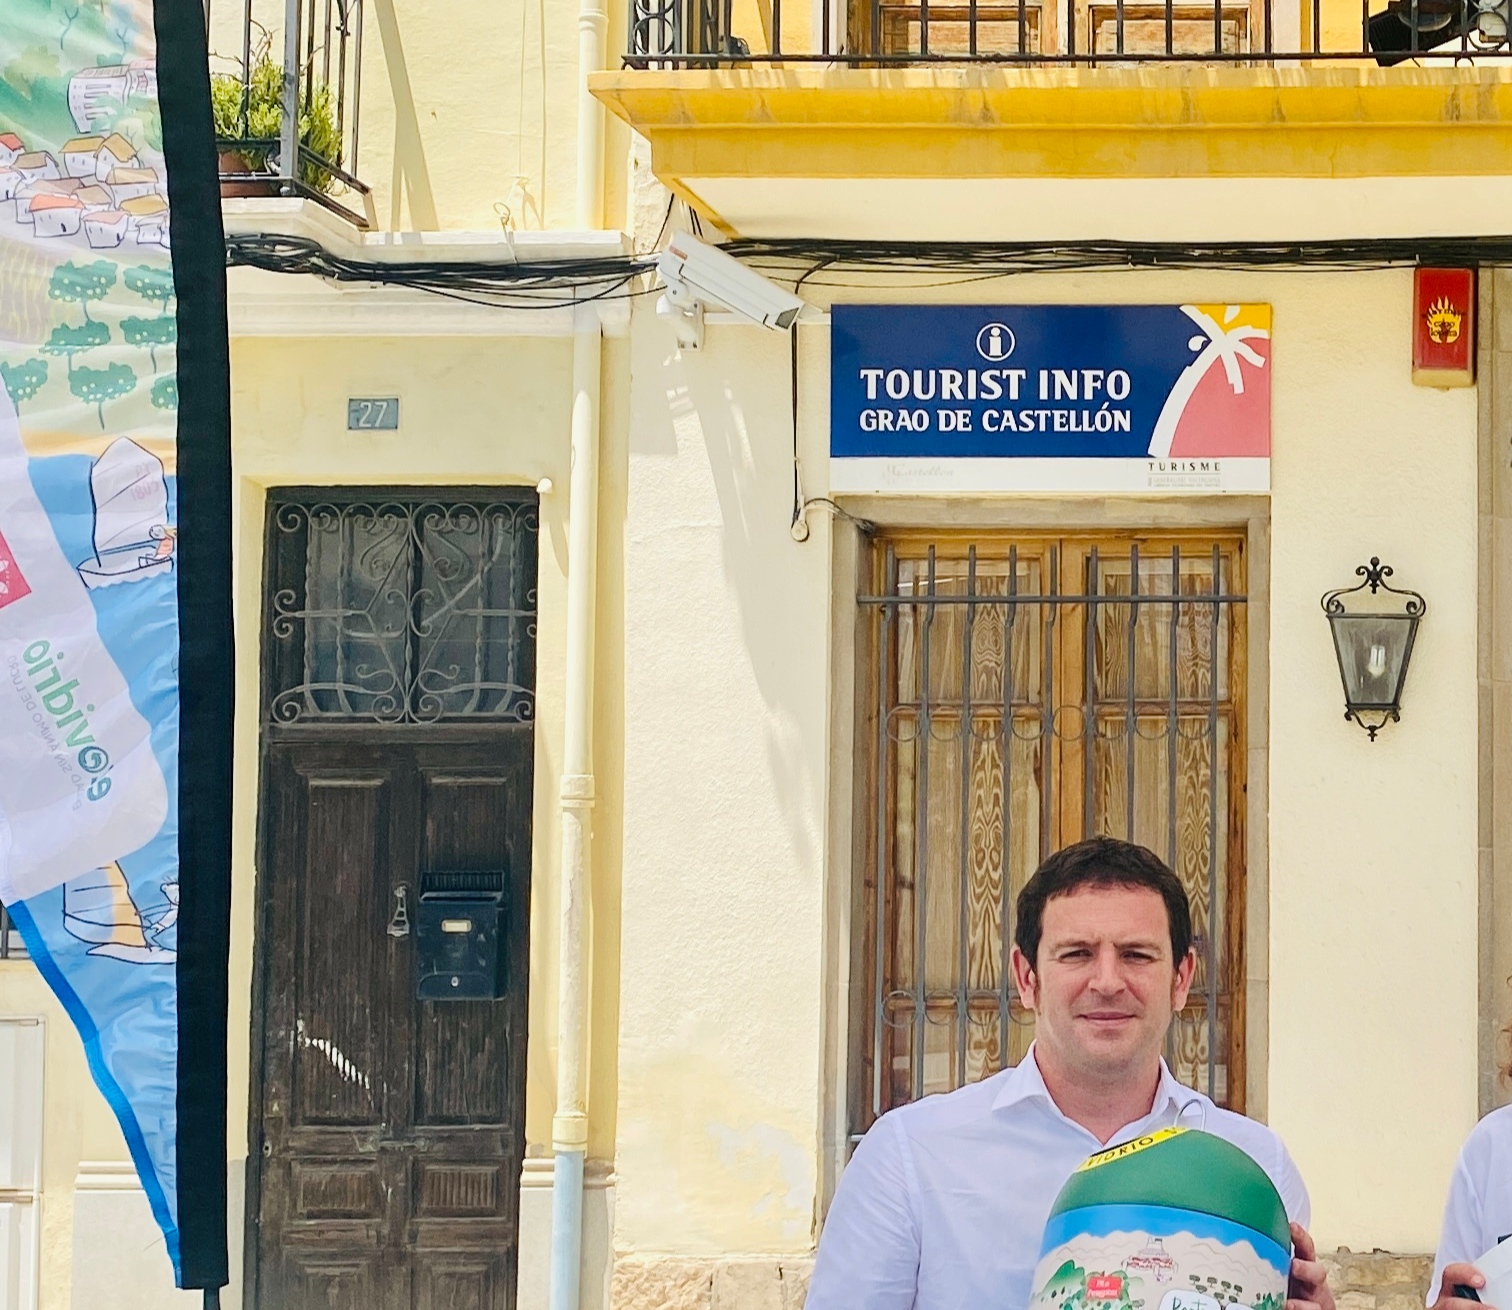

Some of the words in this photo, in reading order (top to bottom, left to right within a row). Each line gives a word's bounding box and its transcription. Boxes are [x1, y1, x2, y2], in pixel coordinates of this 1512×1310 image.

[859, 368, 1027, 400] TOURIST
[1038, 368, 1132, 401] INFO
[358, 401, 388, 428] 27
[859, 409, 930, 432] GRAO
[938, 410, 973, 432] DE
[982, 402, 1132, 432] CASTELLÓN
[1148, 461, 1221, 472] TURISME
